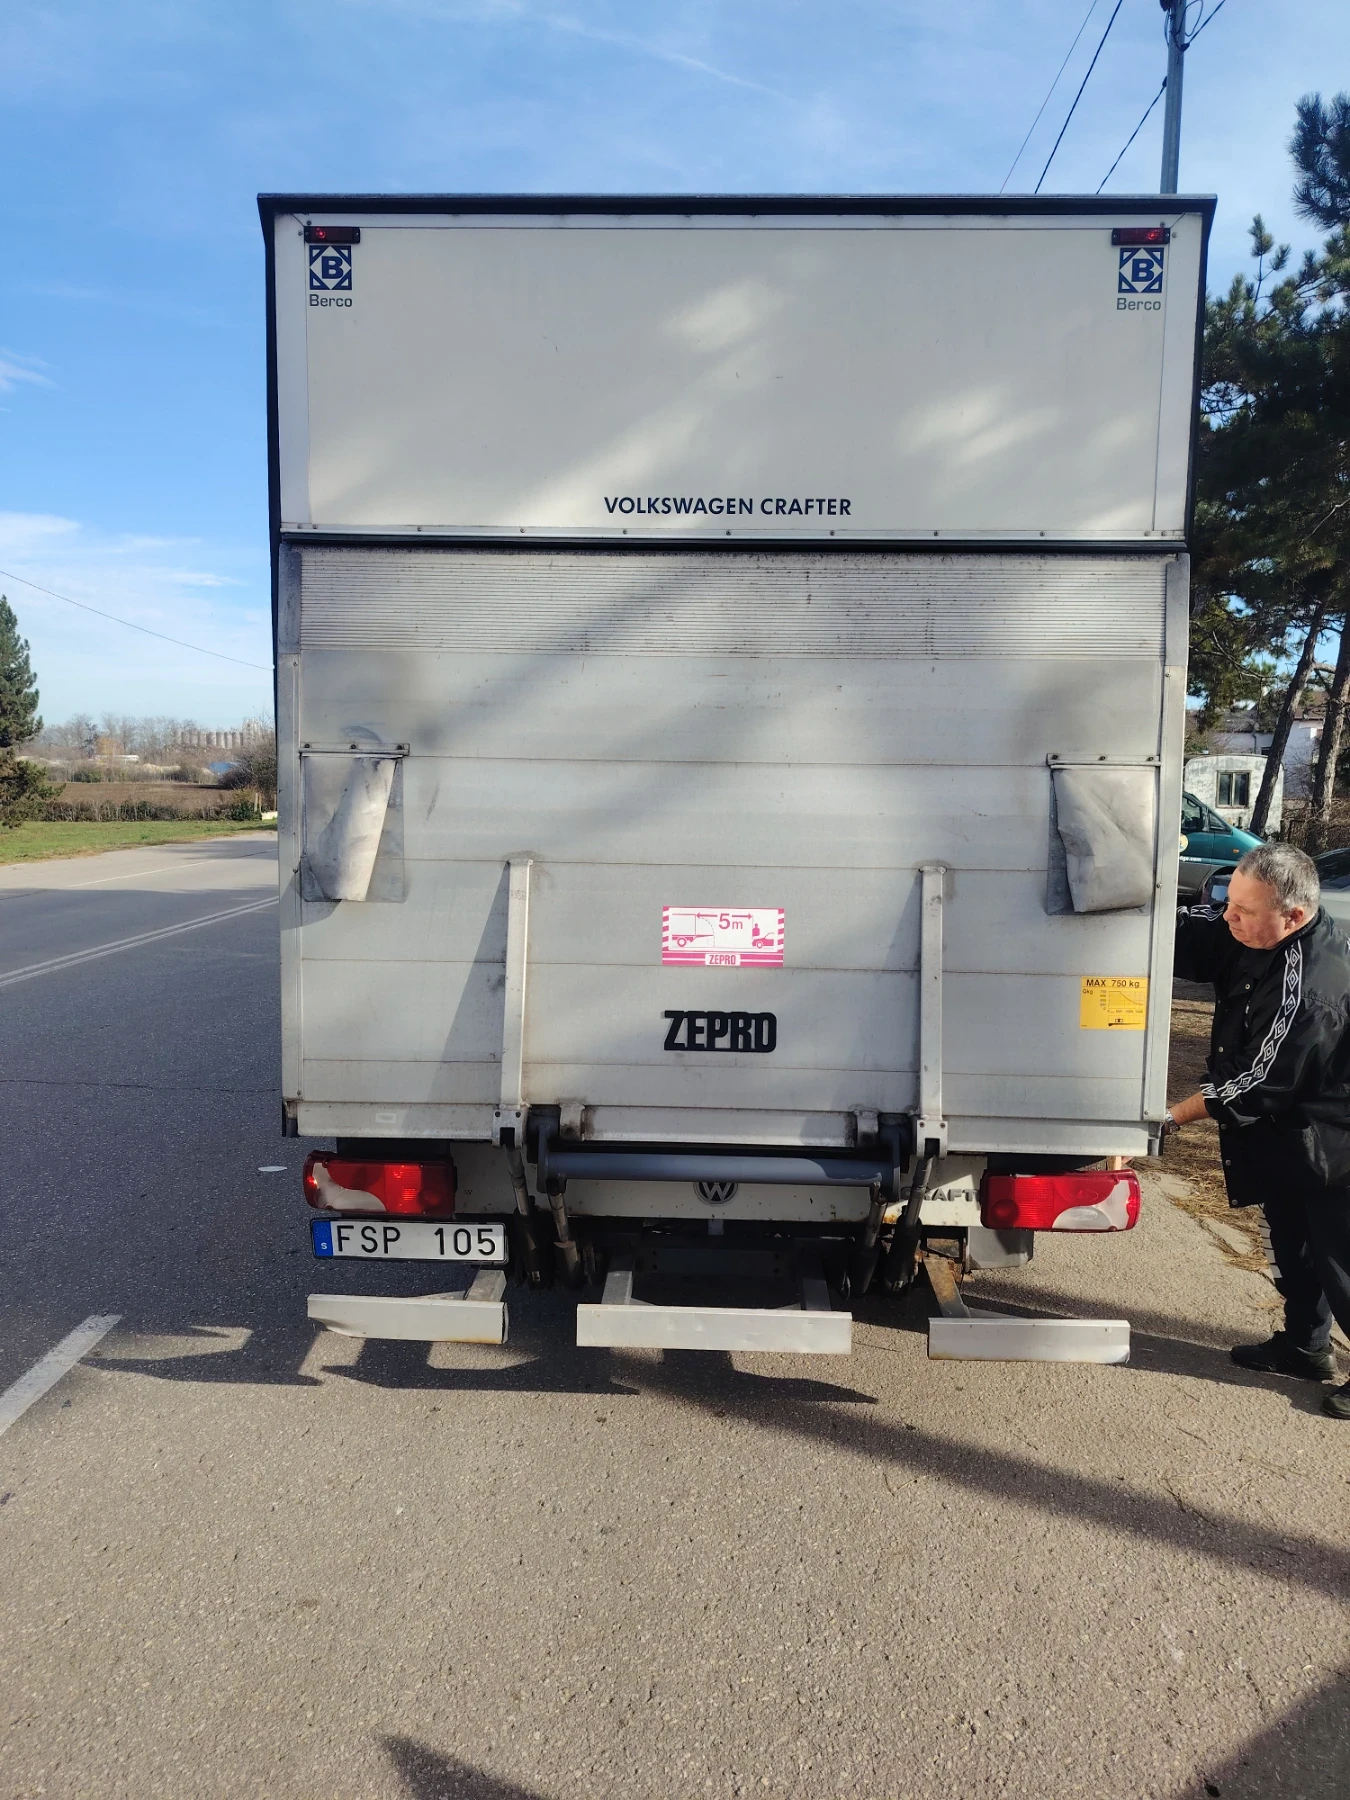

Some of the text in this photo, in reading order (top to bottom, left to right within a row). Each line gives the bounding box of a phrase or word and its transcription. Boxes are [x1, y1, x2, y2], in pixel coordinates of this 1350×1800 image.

[321, 256, 344, 279] B
[1131, 258, 1155, 282] B
[309, 293, 353, 307] Berco
[1116, 297, 1162, 311] Berco
[604, 497, 852, 516] VOLKSWAGEN CRAFTER
[718, 912, 743, 930] 5 m
[708, 954, 737, 965] ZEPRO
[1086, 979, 1140, 989] MAX 750 kg
[663, 1009, 778, 1054] ZEPRO
[320, 1242, 328, 1250] S
[336, 1224, 496, 1256] FSP 105
